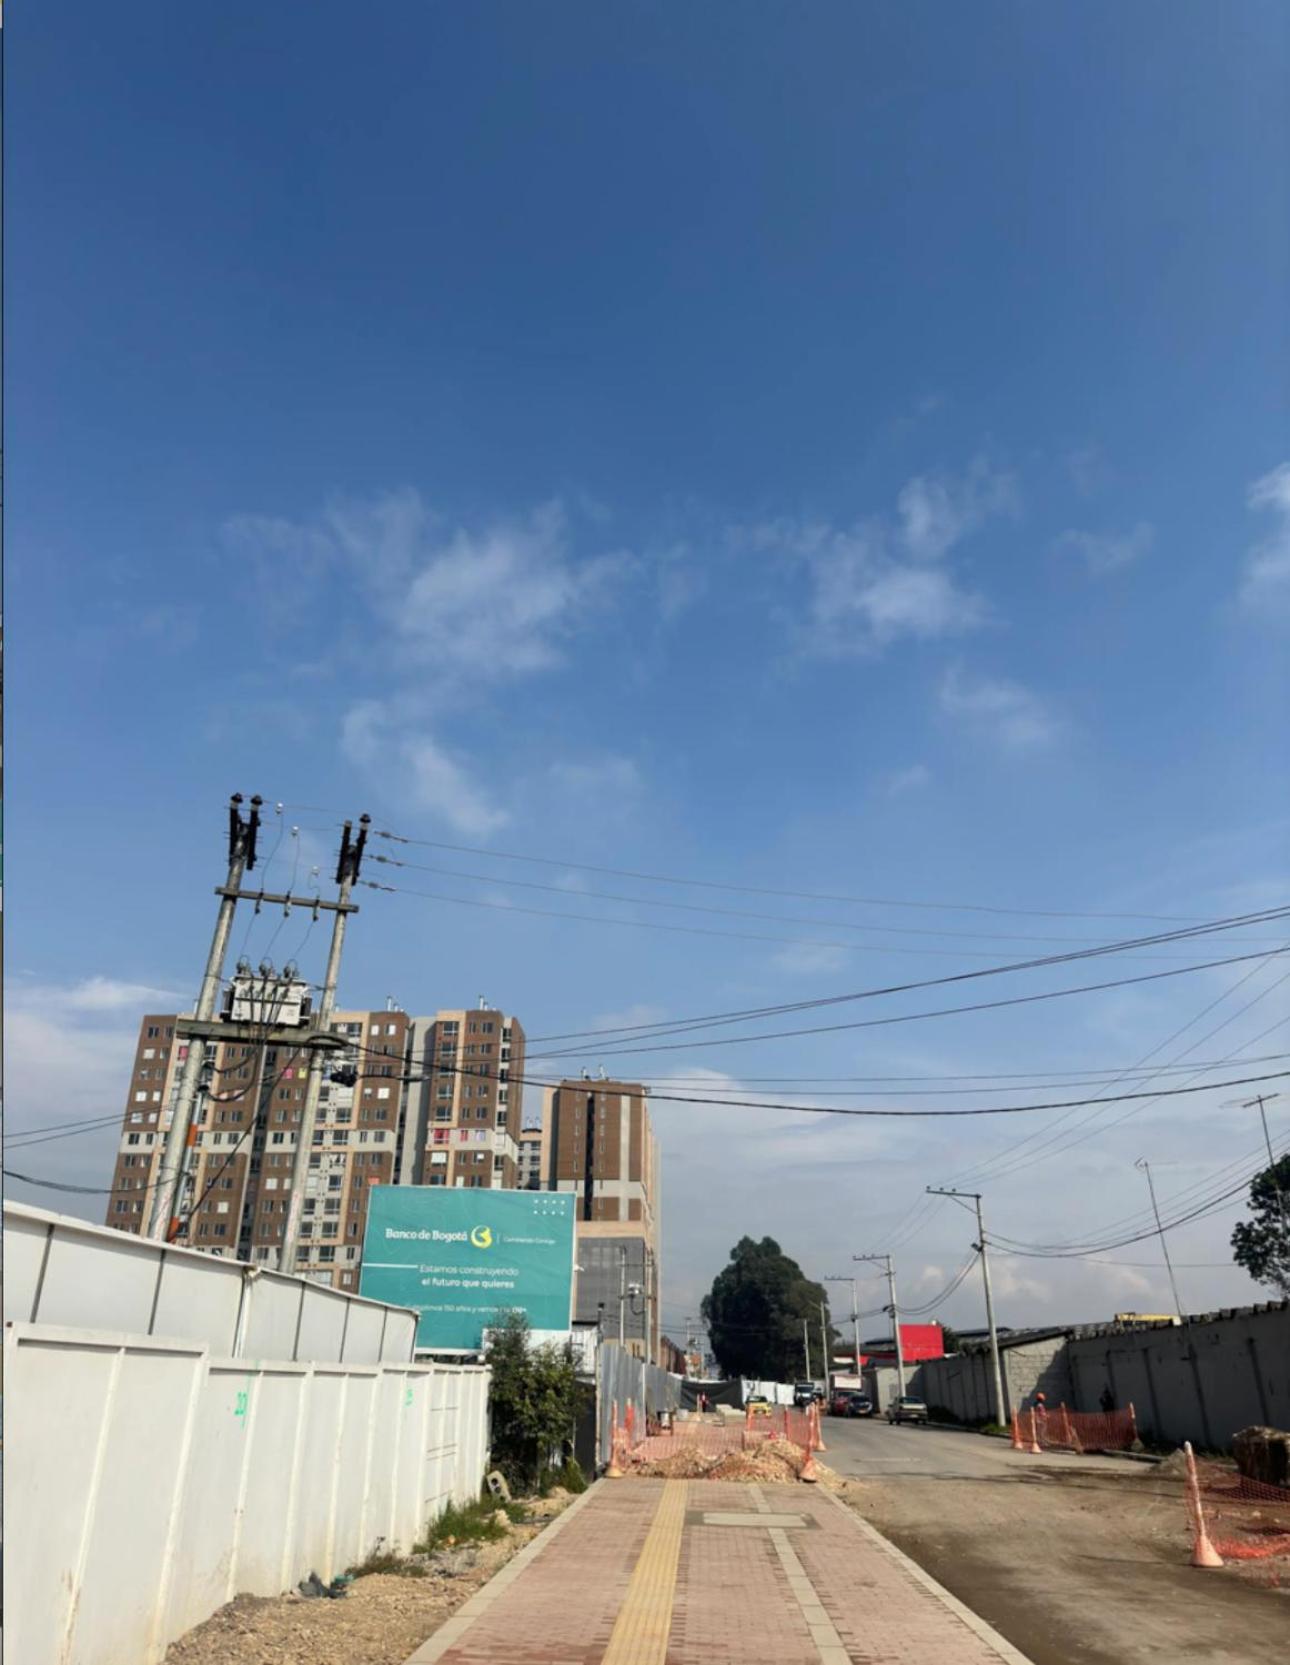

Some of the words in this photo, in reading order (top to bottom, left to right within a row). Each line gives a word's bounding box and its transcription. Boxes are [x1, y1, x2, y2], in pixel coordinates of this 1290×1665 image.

[385, 1228, 417, 1239] Banco
[418, 1230, 431, 1240] de
[432, 1230, 468, 1243] Bogotá
[420, 1264, 457, 1274] Estamos
[459, 1266, 519, 1277] construyendo
[421, 1277, 430, 1286] el
[432, 1278, 460, 1287] futuro
[462, 1280, 480, 1289] que
[481, 1280, 514, 1289] quieres
